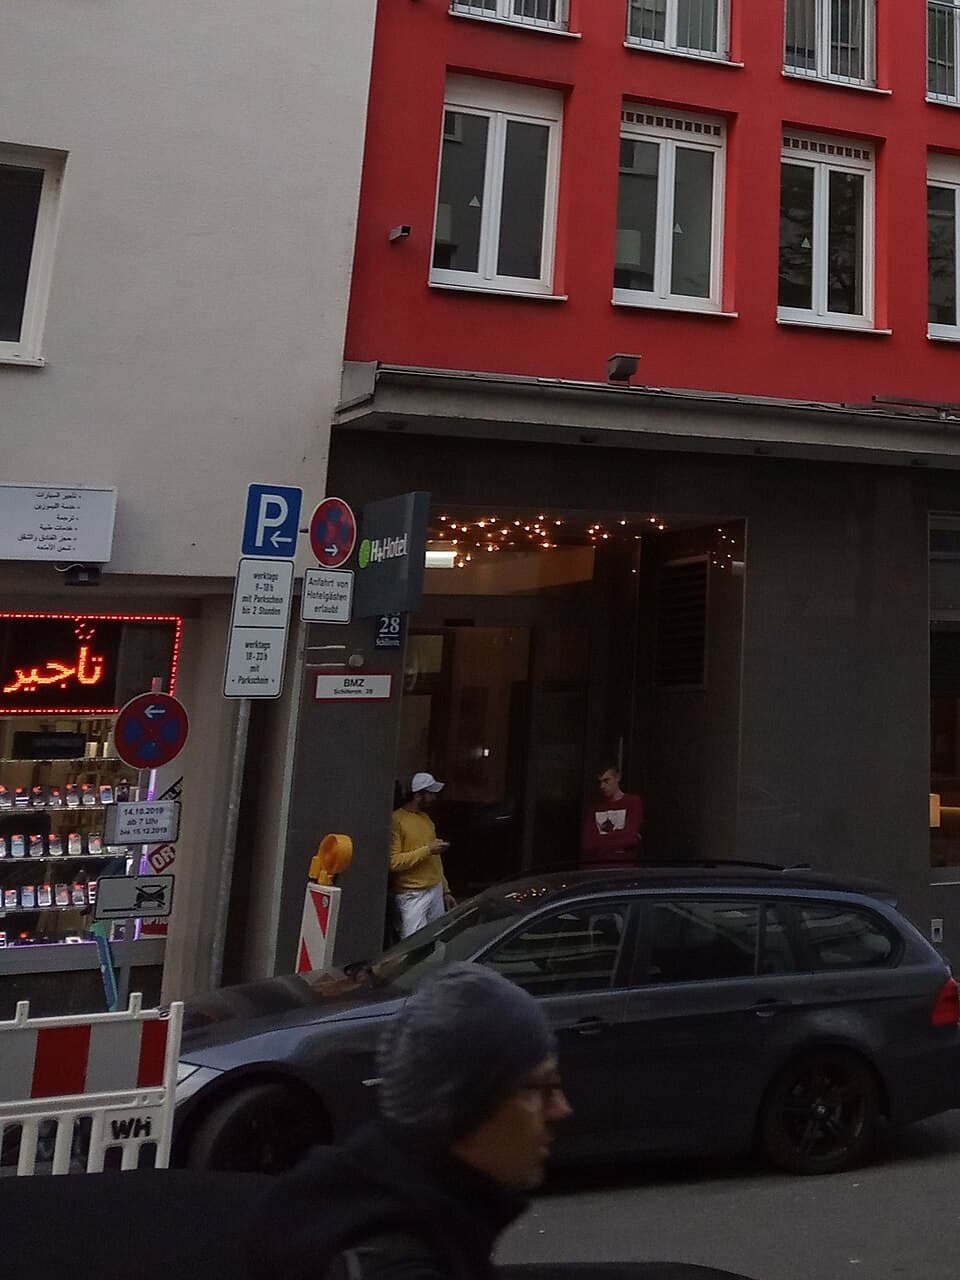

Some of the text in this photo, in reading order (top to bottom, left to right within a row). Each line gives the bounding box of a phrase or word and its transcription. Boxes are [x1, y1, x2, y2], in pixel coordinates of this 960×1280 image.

[255, 493, 289, 547] P
[370, 533, 408, 562] H+Hotel
[253, 572, 279, 584] werktags
[308, 577, 334, 587] Anfahrt
[241, 594, 284, 605] mit Parkschein
[307, 590, 348, 602] Hotelgästen
[241, 606, 281, 616] bis 2 Stunden
[314, 604, 339, 614] erlaubt
[379, 617, 400, 633] 28
[244, 640, 272, 653] werktags
[249, 664, 260, 673] mit
[237, 674, 270, 686] Parkschein
[343, 678, 365, 688] BMZ
[145, 817, 159, 826] Uhr
